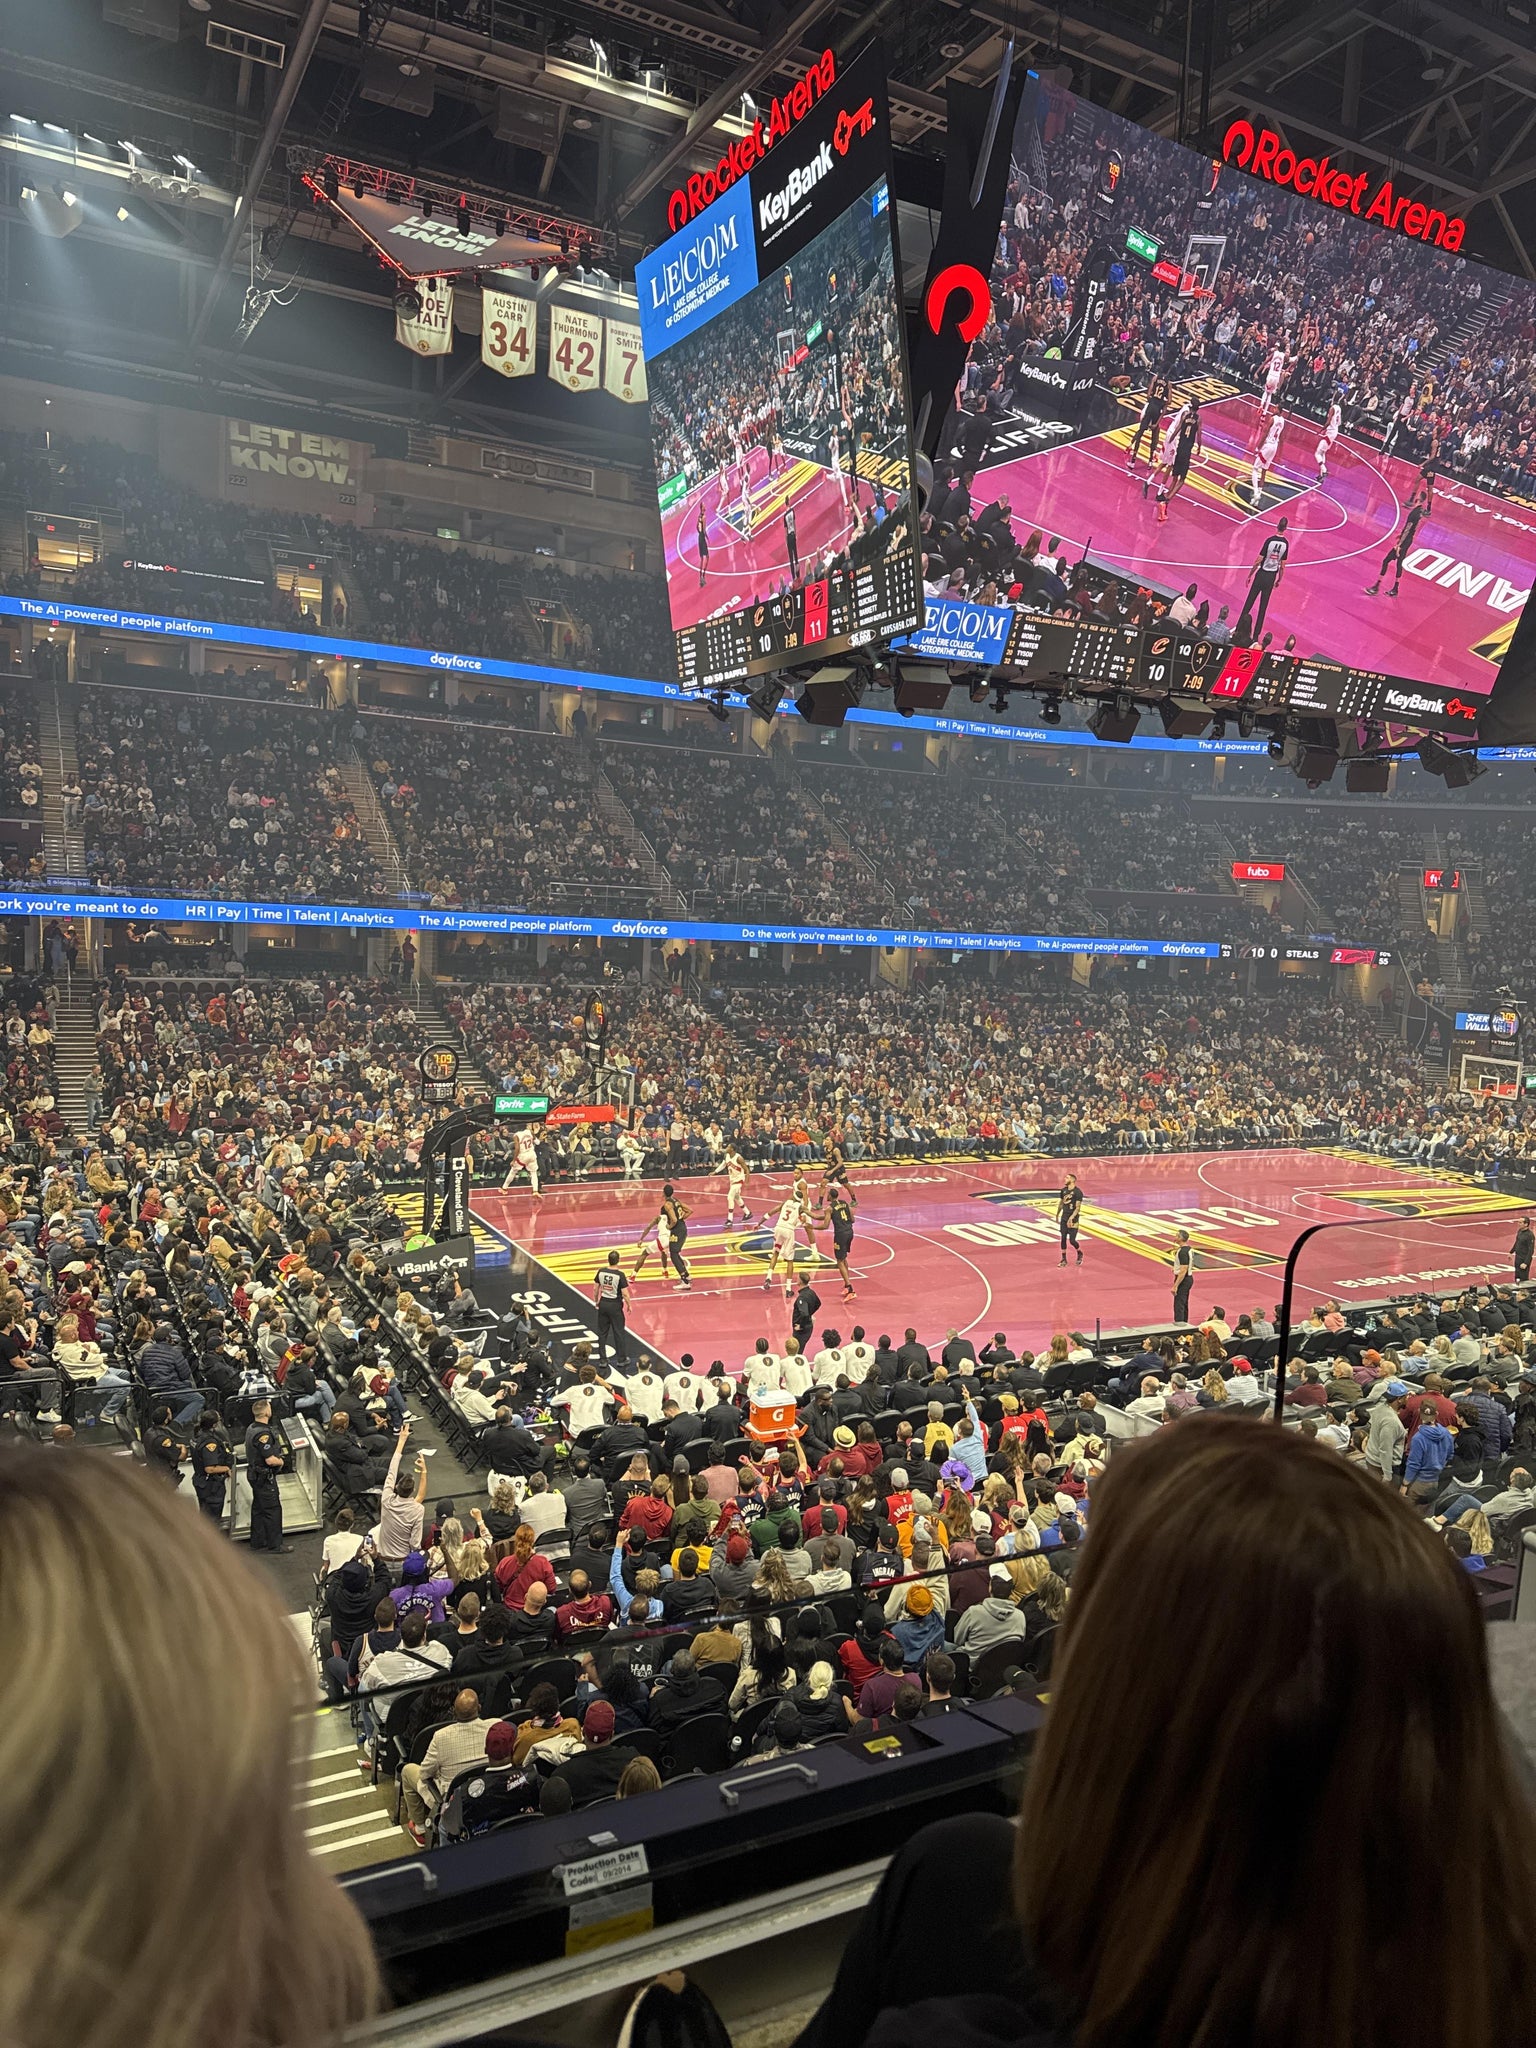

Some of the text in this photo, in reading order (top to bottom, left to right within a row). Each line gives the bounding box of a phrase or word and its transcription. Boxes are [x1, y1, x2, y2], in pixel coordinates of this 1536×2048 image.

[686, 48, 835, 220] Rocket Arena
[758, 141, 835, 232] KeyBank
[1251, 133, 1467, 252] Rocket Arena
[387, 224, 484, 257] KNOW.
[673, 271, 719, 312] LAKE ERIE COLLEGE
[492, 297, 528, 313] AUSTIN
[665, 275, 731, 328] OF OSTEOPATHIC MEDICINE
[417, 311, 448, 329] TAIT
[497, 309, 523, 322] CARR
[565, 314, 588, 328] NATE
[553, 322, 599, 341] THURMOND
[1073, 296, 1093, 357] Cleveland Clinic
[489, 320, 530, 362] 34
[615, 336, 643, 351] SMITH
[555, 336, 595, 377] 42
[621, 351, 638, 385] 7
[1020, 363, 1052, 383] KeyBank
[228, 420, 350, 460] LET EM
[230, 445, 356, 486] KNOW.
[137, 561, 165, 573] KeyBank
[19, 601, 213, 635] The AI-powered people platform
[924, 605, 1007, 641] ECOM
[1025, 615, 1052, 625] CLEVELAND
[1052, 618, 1075, 628] CAVALIERS
[810, 619, 821, 638] 11
[1123, 629, 1138, 637] FOULS
[759, 634, 771, 653] 10
[921, 637, 975, 650] LAKE ERIE COLLEGE
[1179, 644, 1191, 656] 1Q
[918, 645, 959, 657] OSTEOPATHIC
[959, 650, 984, 660] MEDICINE
[1016, 650, 1034, 658] TYSON
[1216, 648, 1224, 661] 7
[430, 653, 483, 672] dayforce
[1014, 658, 1029, 666] WADE
[1321, 663, 1343, 672] RAPTORS
[1148, 663, 1165, 681] 10
[1183, 674, 1204, 690] 7:09
[1224, 676, 1240, 692] 11
[663, 685, 677, 696] Do
[777, 700, 789, 709] do
[1385, 689, 1445, 715] KeyBank
[935, 719, 1047, 741] HR Pay Time Talent Analytics
[1198, 741, 1212, 751] The
[1214, 742, 1261, 753] AI-powered
[1246, 866, 1270, 877] fubo
[0, 899, 395, 925] ork you're meant to do HR Pay Time Talent Analytics
[419, 915, 668, 938] The AI-powered people platform dayforce
[742, 928, 878, 943] Do the work you're meant to do
[894, 934, 1021, 948] HR Pay Time Talent Analytics
[1036, 940, 1207, 956] The AI-powered people platform dayforce
[1251, 947, 1342, 961] 10 0 STEALS 2
[433, 1054, 452, 1064] 7:09
[497, 1100, 525, 1110] Sprite
[522, 1139, 533, 1150] 12
[454, 1171, 463, 1232] Cleveland Clinic
[782, 1210, 792, 1221] 3
[840, 1210, 848, 1221] 4
[397, 1260, 438, 1277] yBank
[603, 1275, 613, 1285] 52
[1333, 1272, 1418, 1288] Arena
[772, 1408, 784, 1422] G
[627, 1489, 646, 1498] ALLEN
[872, 1568, 896, 1577] INGRAM
[398, 1597, 434, 1616] RAPTORS
[567, 1849, 640, 1877] Production Date
[569, 1864, 632, 1889] Code: 09/2014
